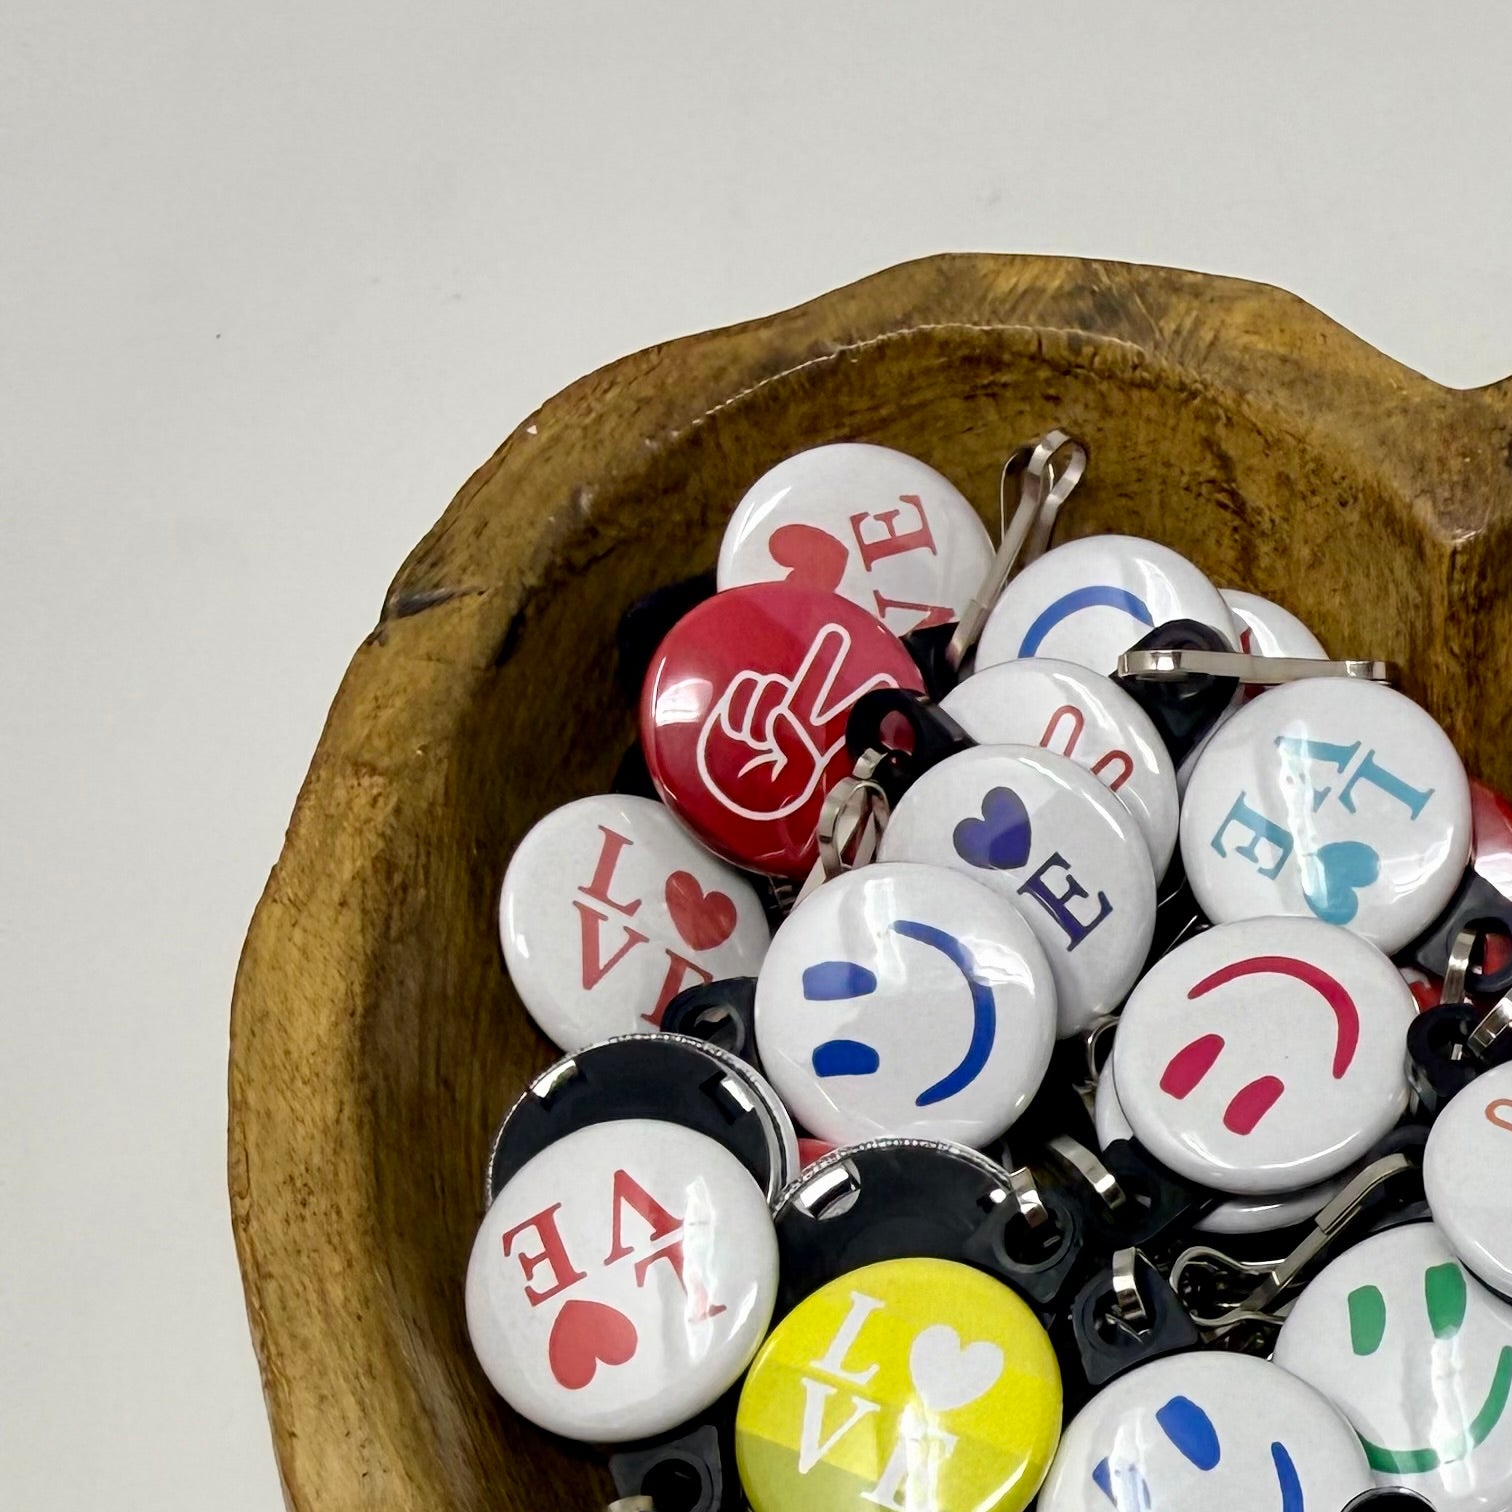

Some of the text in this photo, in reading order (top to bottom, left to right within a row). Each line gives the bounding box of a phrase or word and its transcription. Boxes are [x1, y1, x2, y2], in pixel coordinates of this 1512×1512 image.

[1210, 734, 1362, 882] VE
[1338, 747, 1436, 822] L
[577, 824, 642, 918] L
[501, 1168, 686, 1308] VE
[810, 1290, 886, 1386] L
